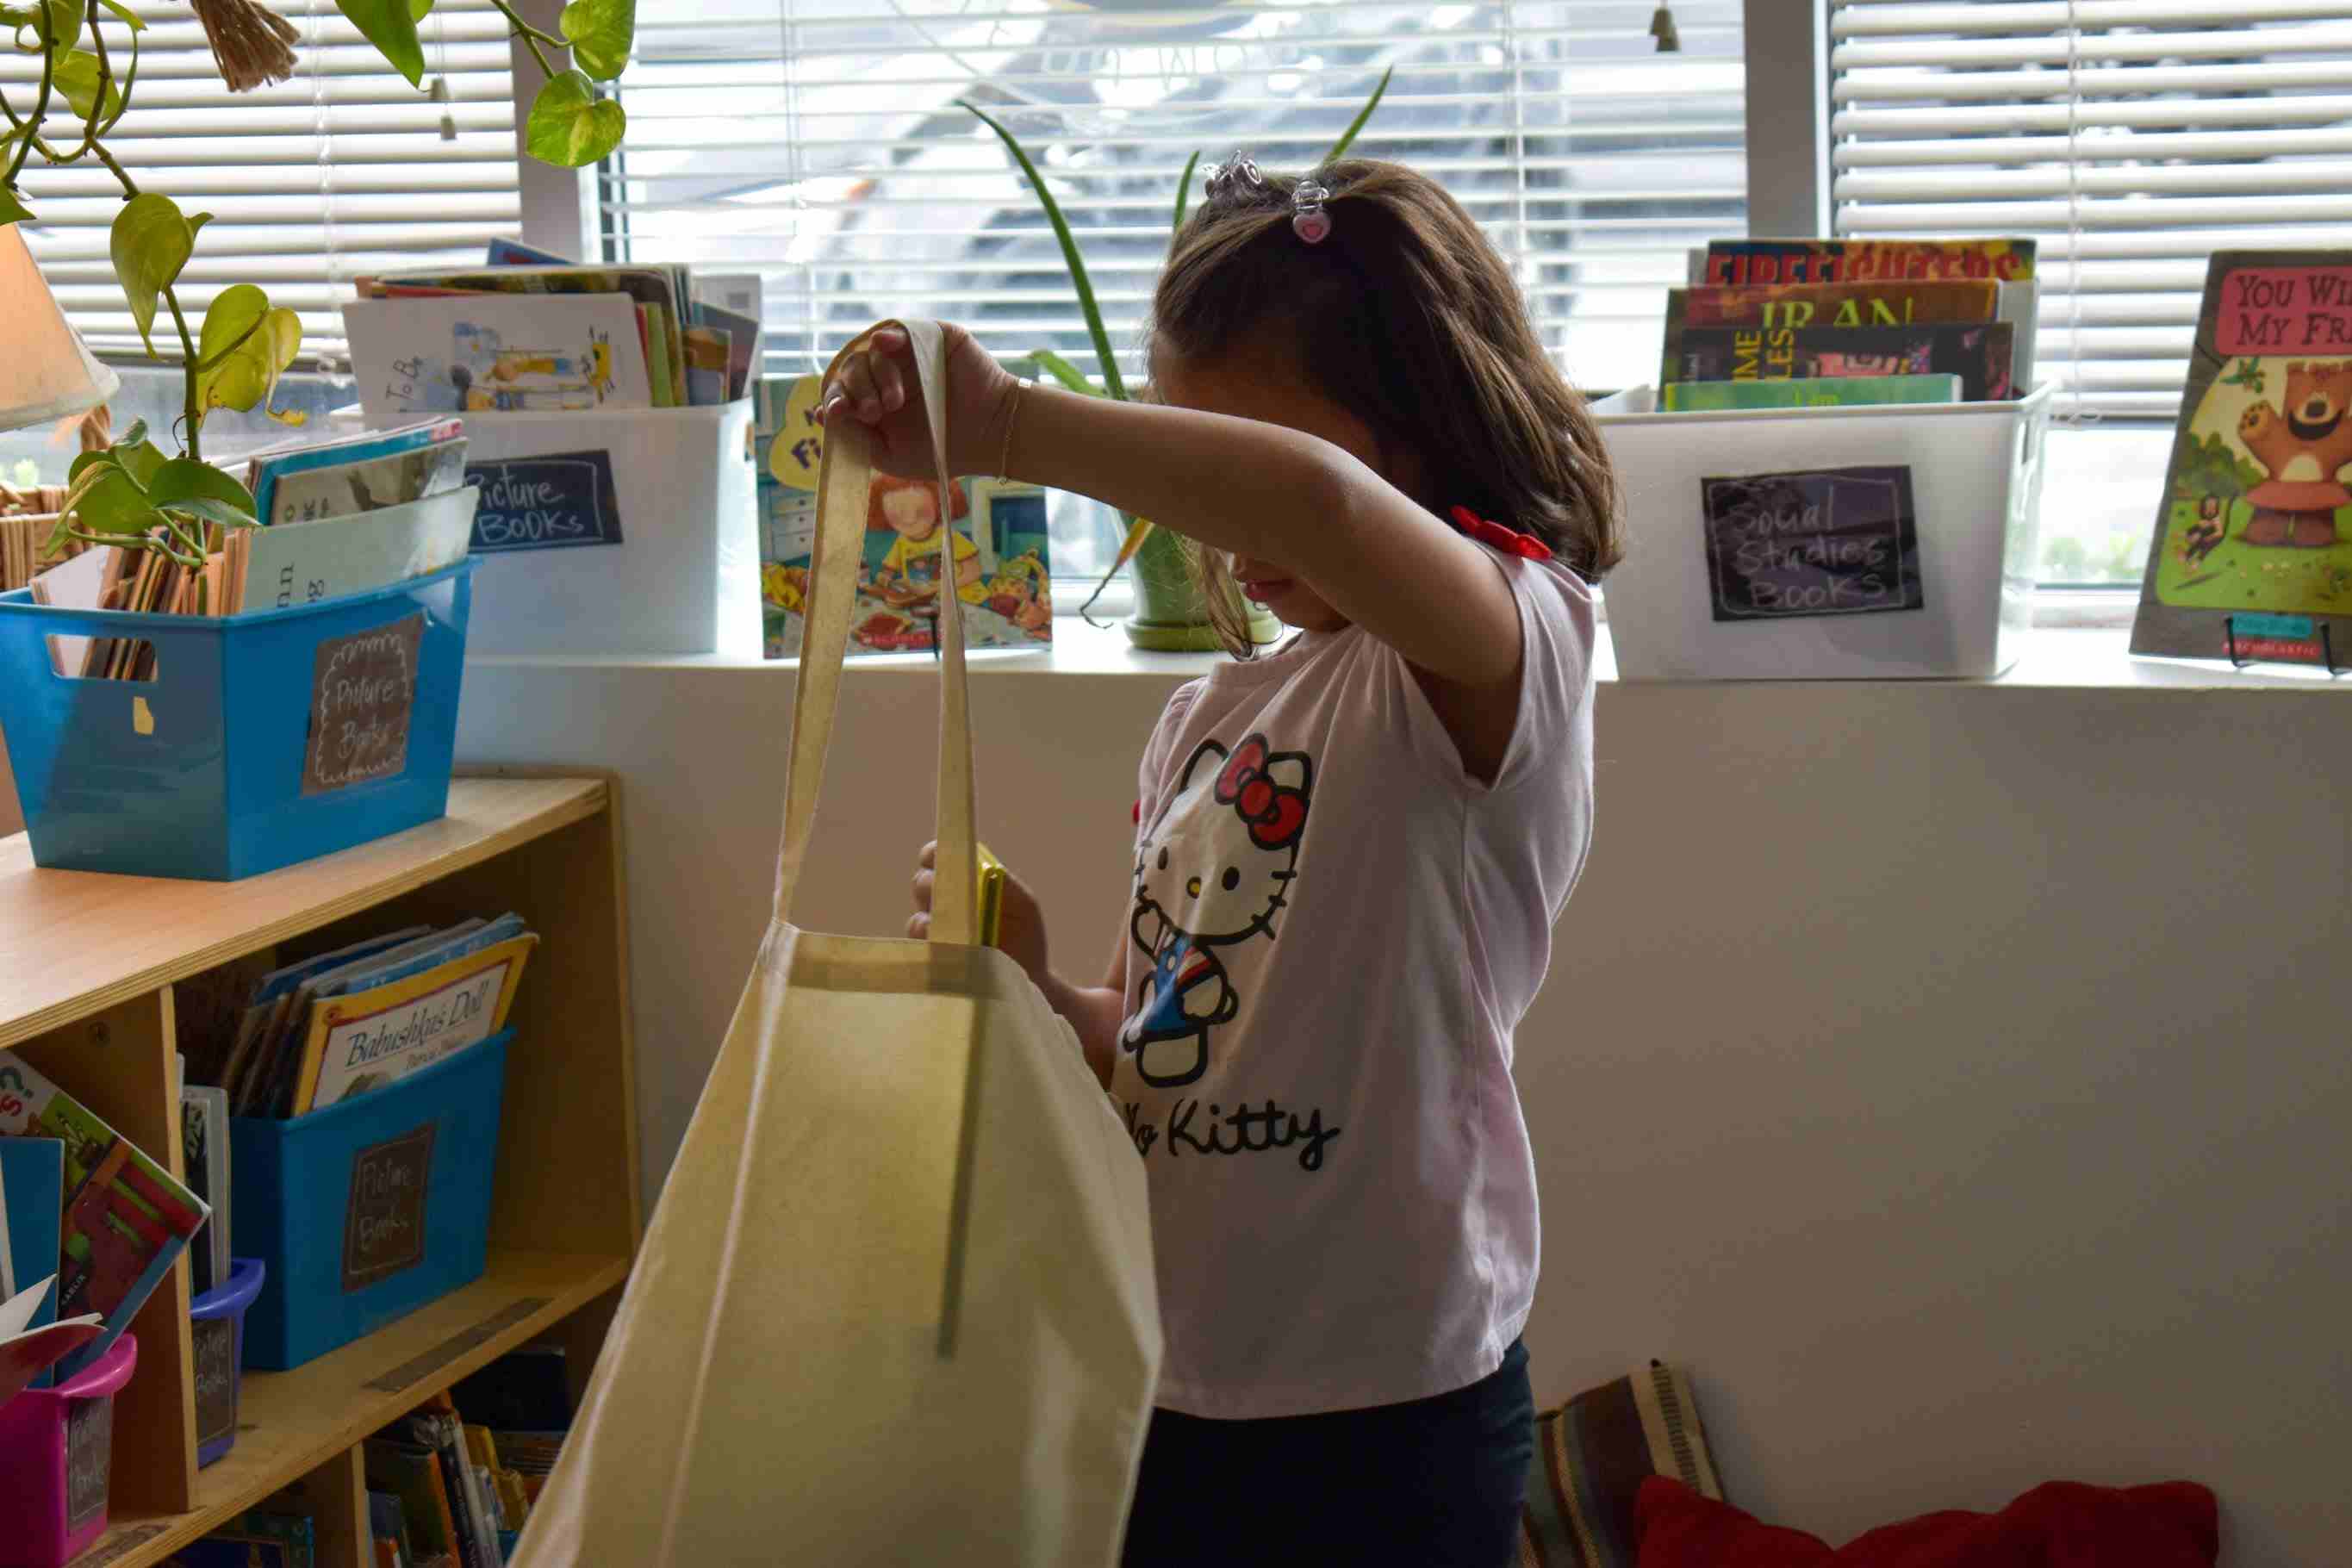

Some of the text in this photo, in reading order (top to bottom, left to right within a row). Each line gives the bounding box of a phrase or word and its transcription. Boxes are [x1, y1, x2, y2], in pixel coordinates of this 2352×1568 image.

[2236, 275, 2295, 308] YOU
[2236, 312, 2292, 346] MY
[463, 463, 565, 509] Picture
[1733, 534, 1887, 574] Studies
[447, 978, 491, 1027] Doll
[1167, 1097, 1341, 1172] Kitty
